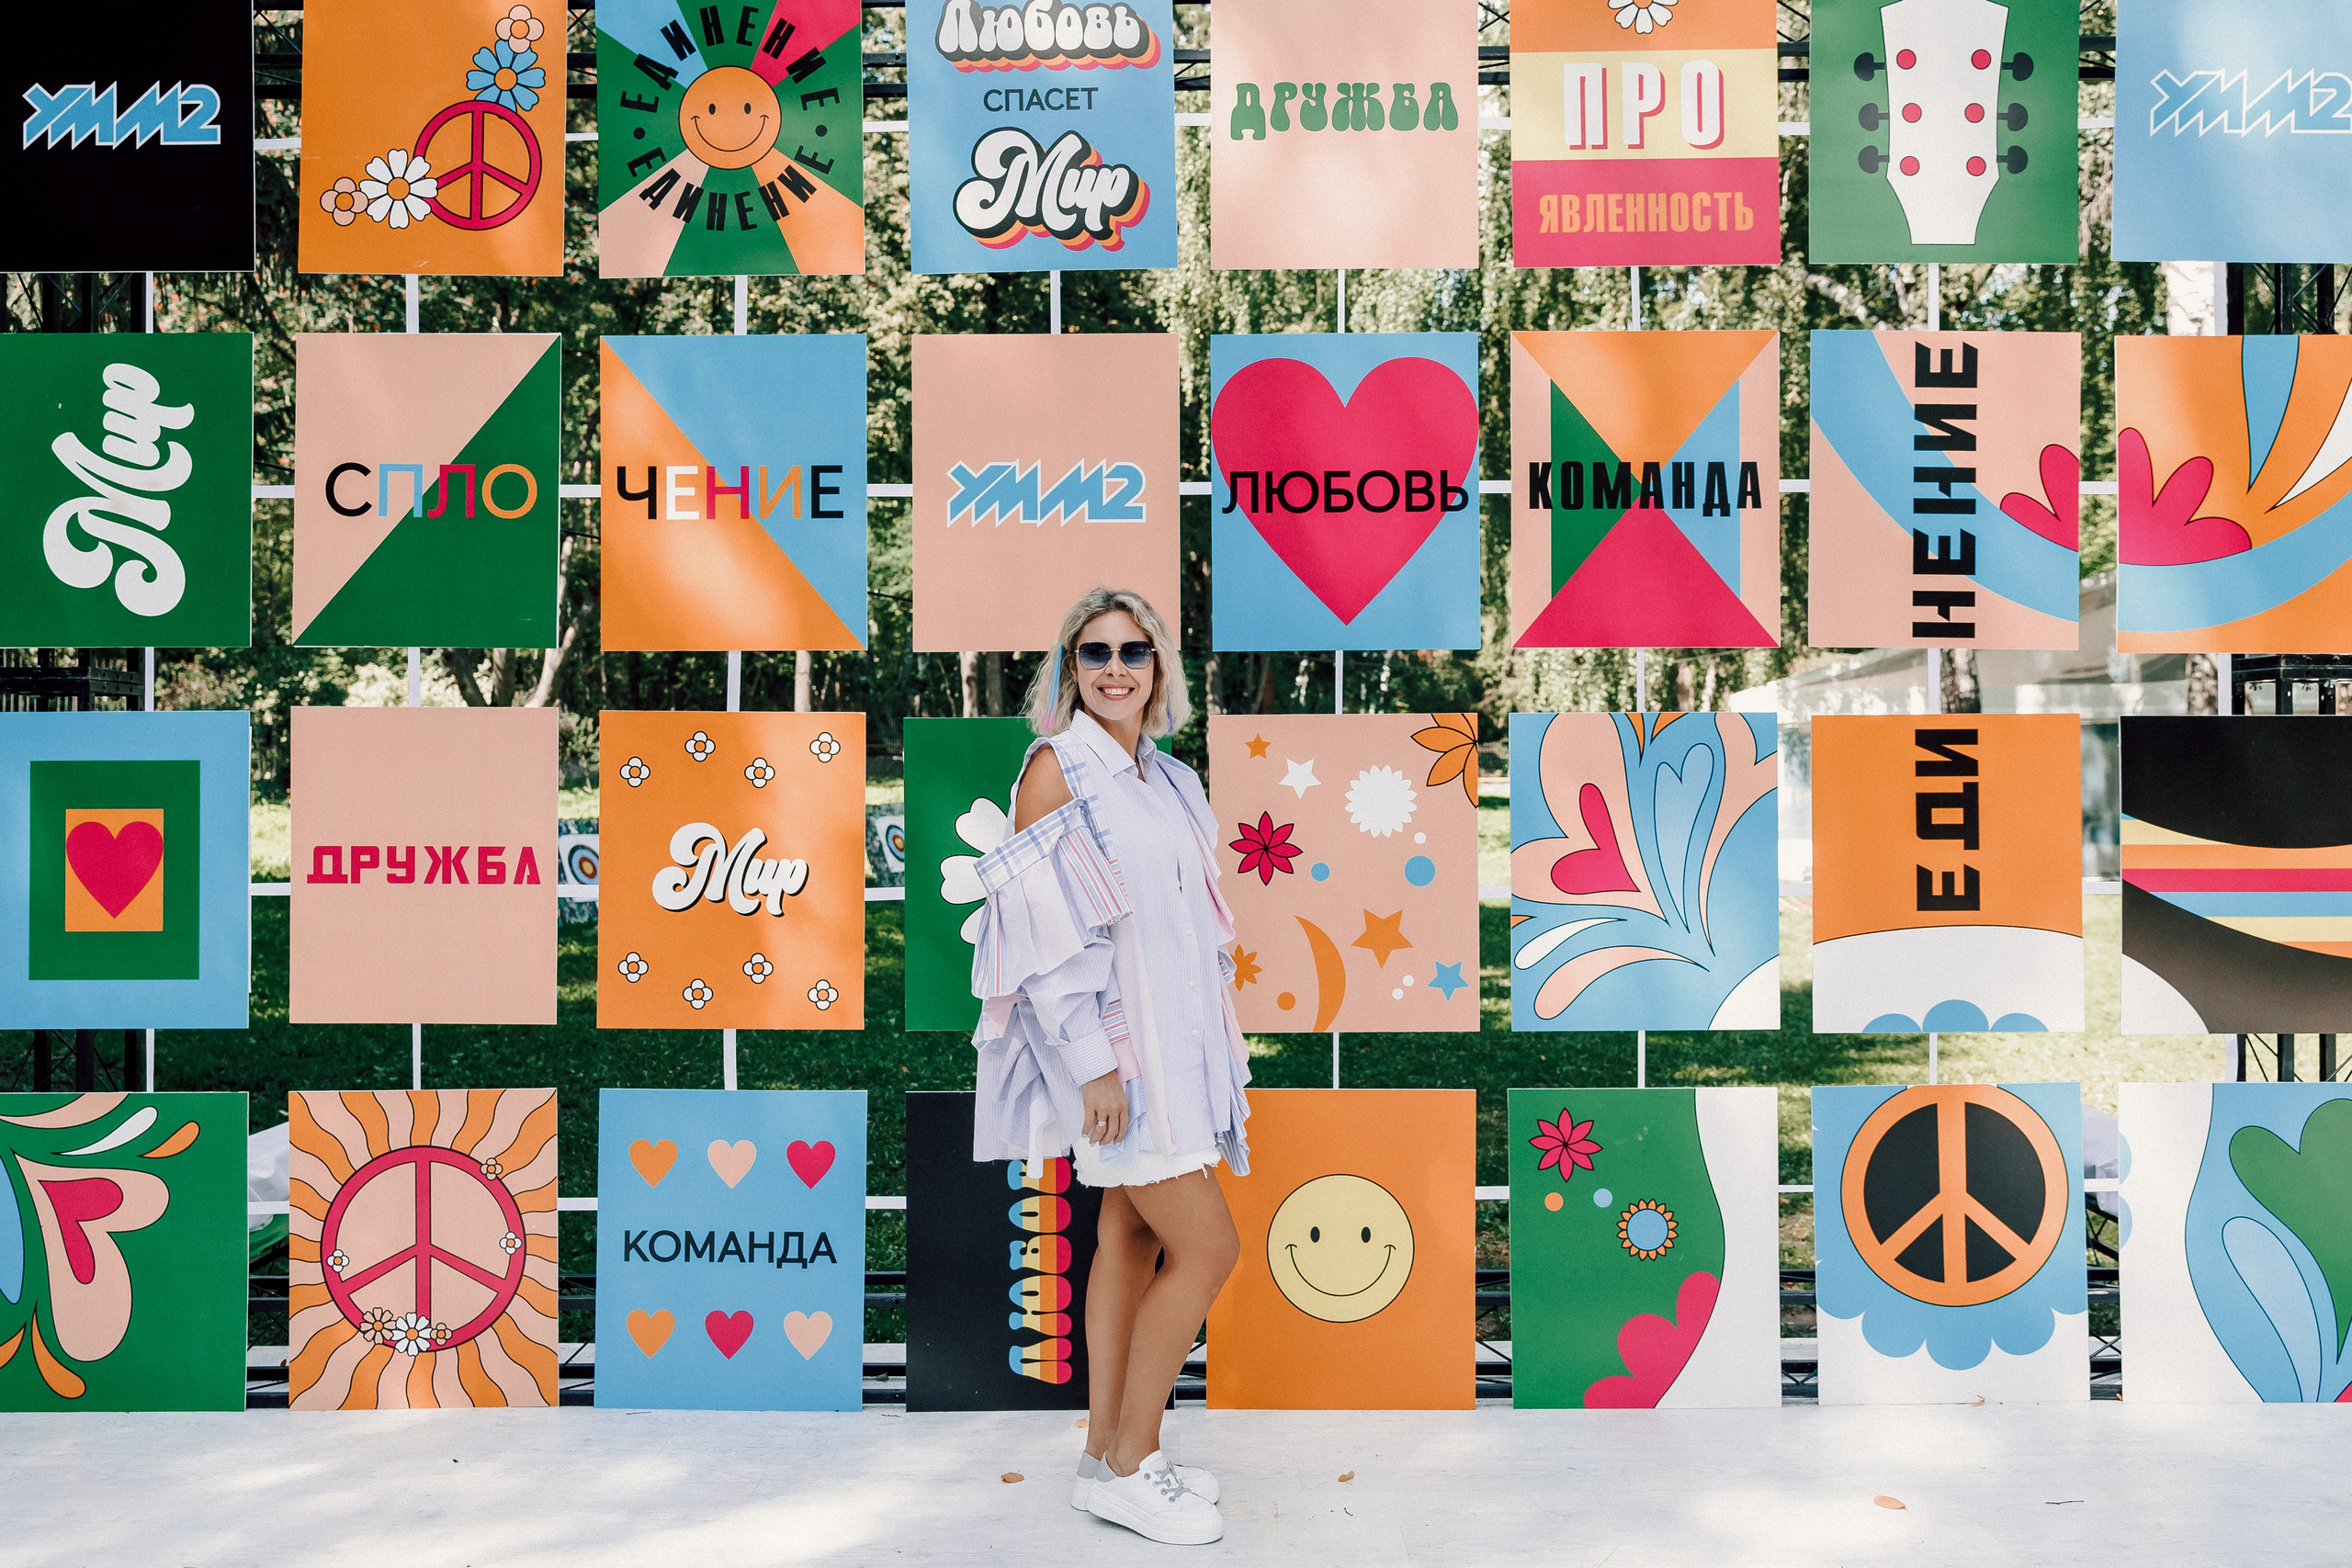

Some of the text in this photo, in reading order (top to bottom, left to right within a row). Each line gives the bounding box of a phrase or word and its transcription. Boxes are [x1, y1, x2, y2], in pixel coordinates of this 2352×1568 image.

[619, 5, 840, 114] ЕДИНЕНИЕ
[983, 87, 1099, 112] СПАСЕТ
[1230, 82, 1459, 141] ДРУЖБА
[1564, 59, 1724, 150] ПРО
[627, 144, 834, 231] ЕДИНЕНИЕ
[953, 127, 1145, 248] Мир
[1539, 192, 1754, 233] ЯВЛЕННОСТЬ
[324, 462, 538, 519] СПЛО
[616, 465, 844, 520] ЧЕНИЕ
[1222, 469, 1469, 513] ЛЮБОВЬ
[1529, 461, 1761, 517] КОМАНДА
[1912, 341, 1978, 638] НЕНИЕ
[1914, 728, 1980, 911] ЕДИ
[306, 846, 541, 885] ДРУЖБА
[651, 822, 809, 917] Мир
[623, 1230, 837, 1269] КОМАНДА
[1007, 1156, 1072, 1384] ЛЮБОВ
